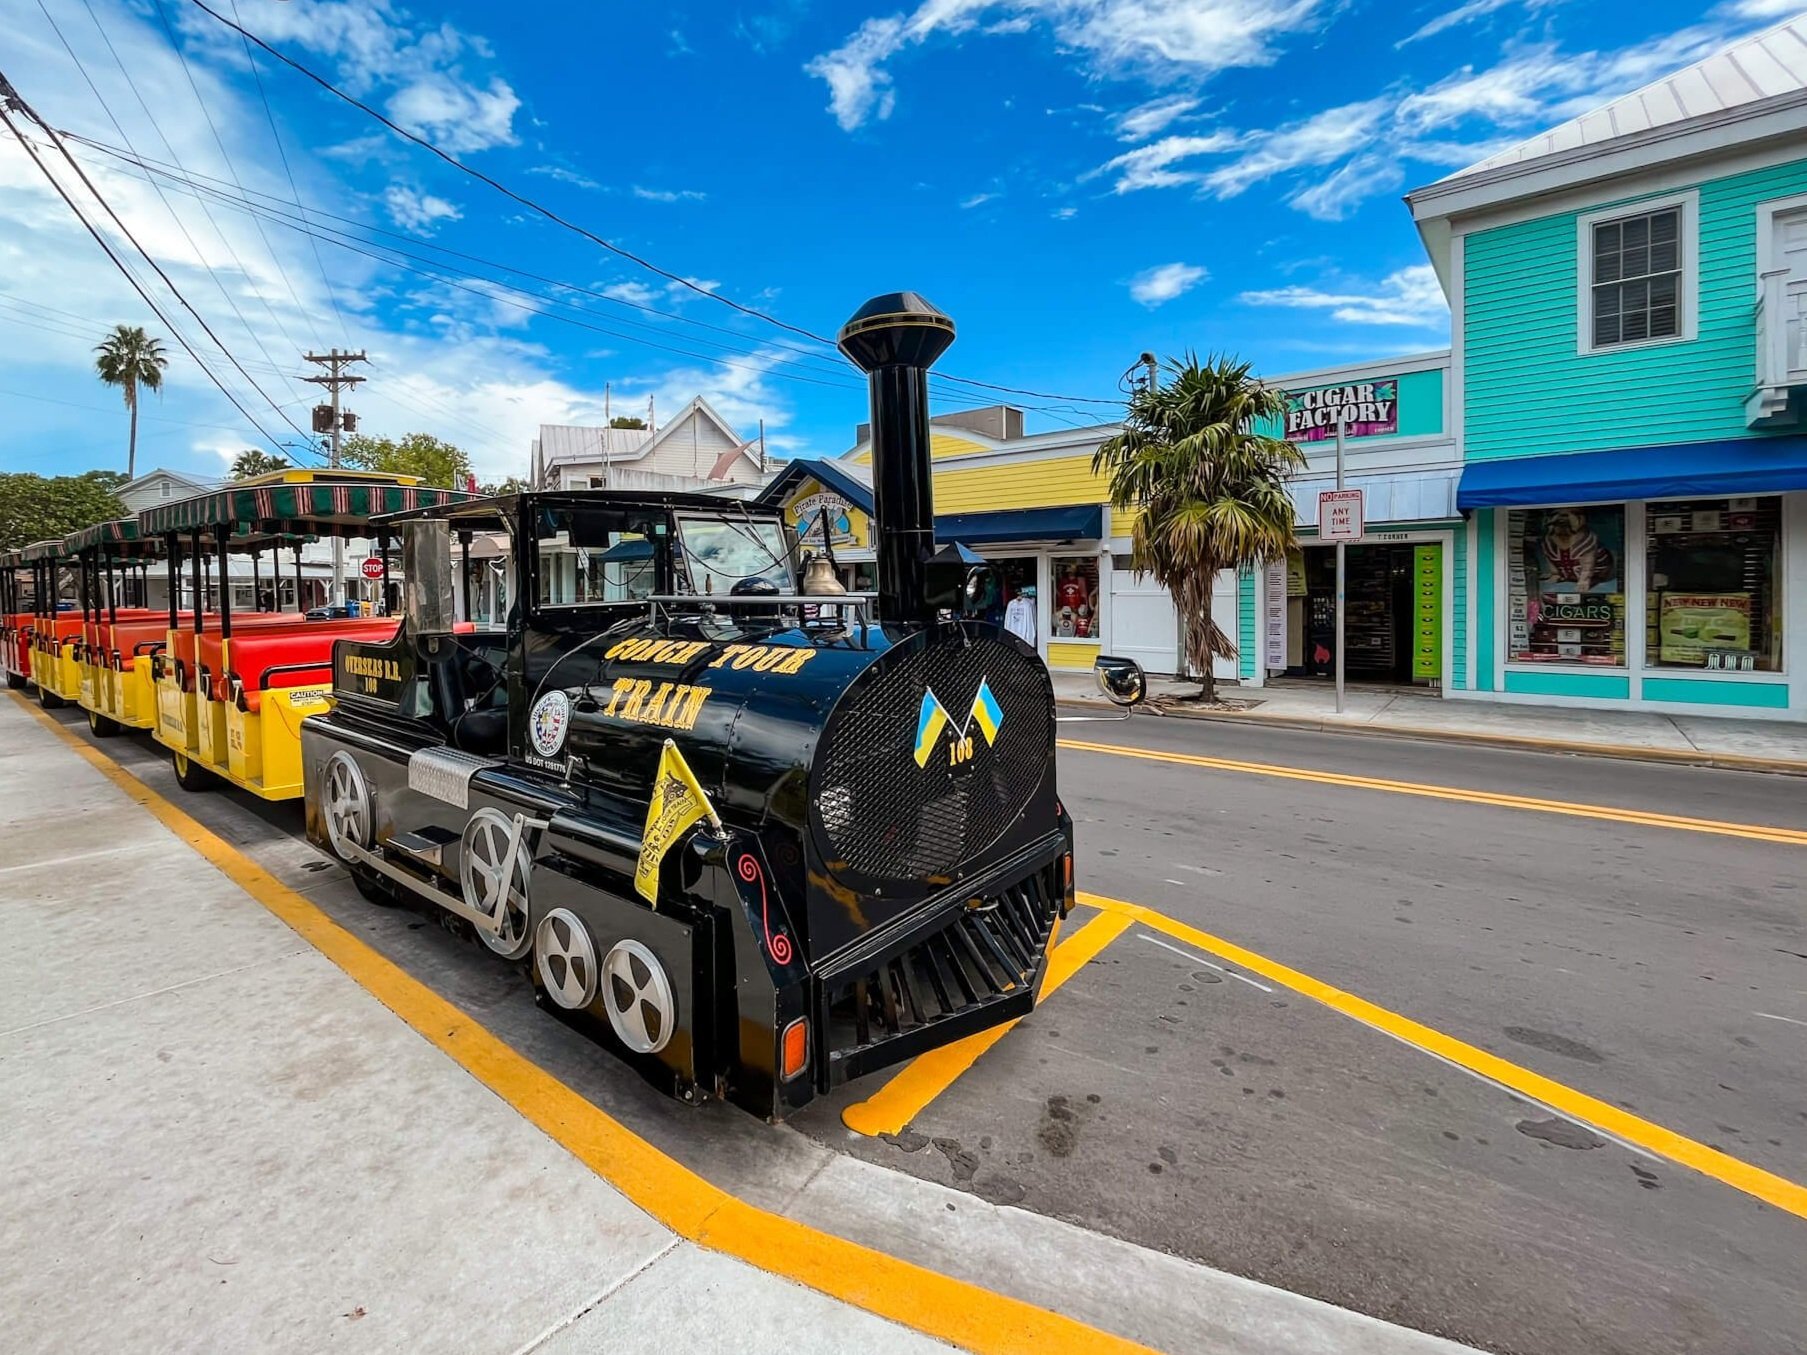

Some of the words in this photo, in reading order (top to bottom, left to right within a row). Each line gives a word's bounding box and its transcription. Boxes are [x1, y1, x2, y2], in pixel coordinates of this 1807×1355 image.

[1303, 384, 1374, 409] CIGAR
[1288, 401, 1391, 432] FACTORY
[1320, 493, 1333, 502] NO
[1334, 492, 1359, 500] PARKING
[794, 498, 817, 514] Pirate
[1332, 508, 1349, 516] ANY
[1332, 518, 1351, 526] TIME
[363, 564, 384, 573] STOP
[1543, 605, 1611, 620] CIGARS
[604, 638, 711, 664] CONCH
[708, 644, 816, 674] TOUR
[345, 655, 382, 678] OVERSEAS
[290, 690, 323, 699] CAUTION
[604, 677, 712, 730] TRAIN
[950, 736, 973, 766] 108
[533, 757, 543, 767] DOT
